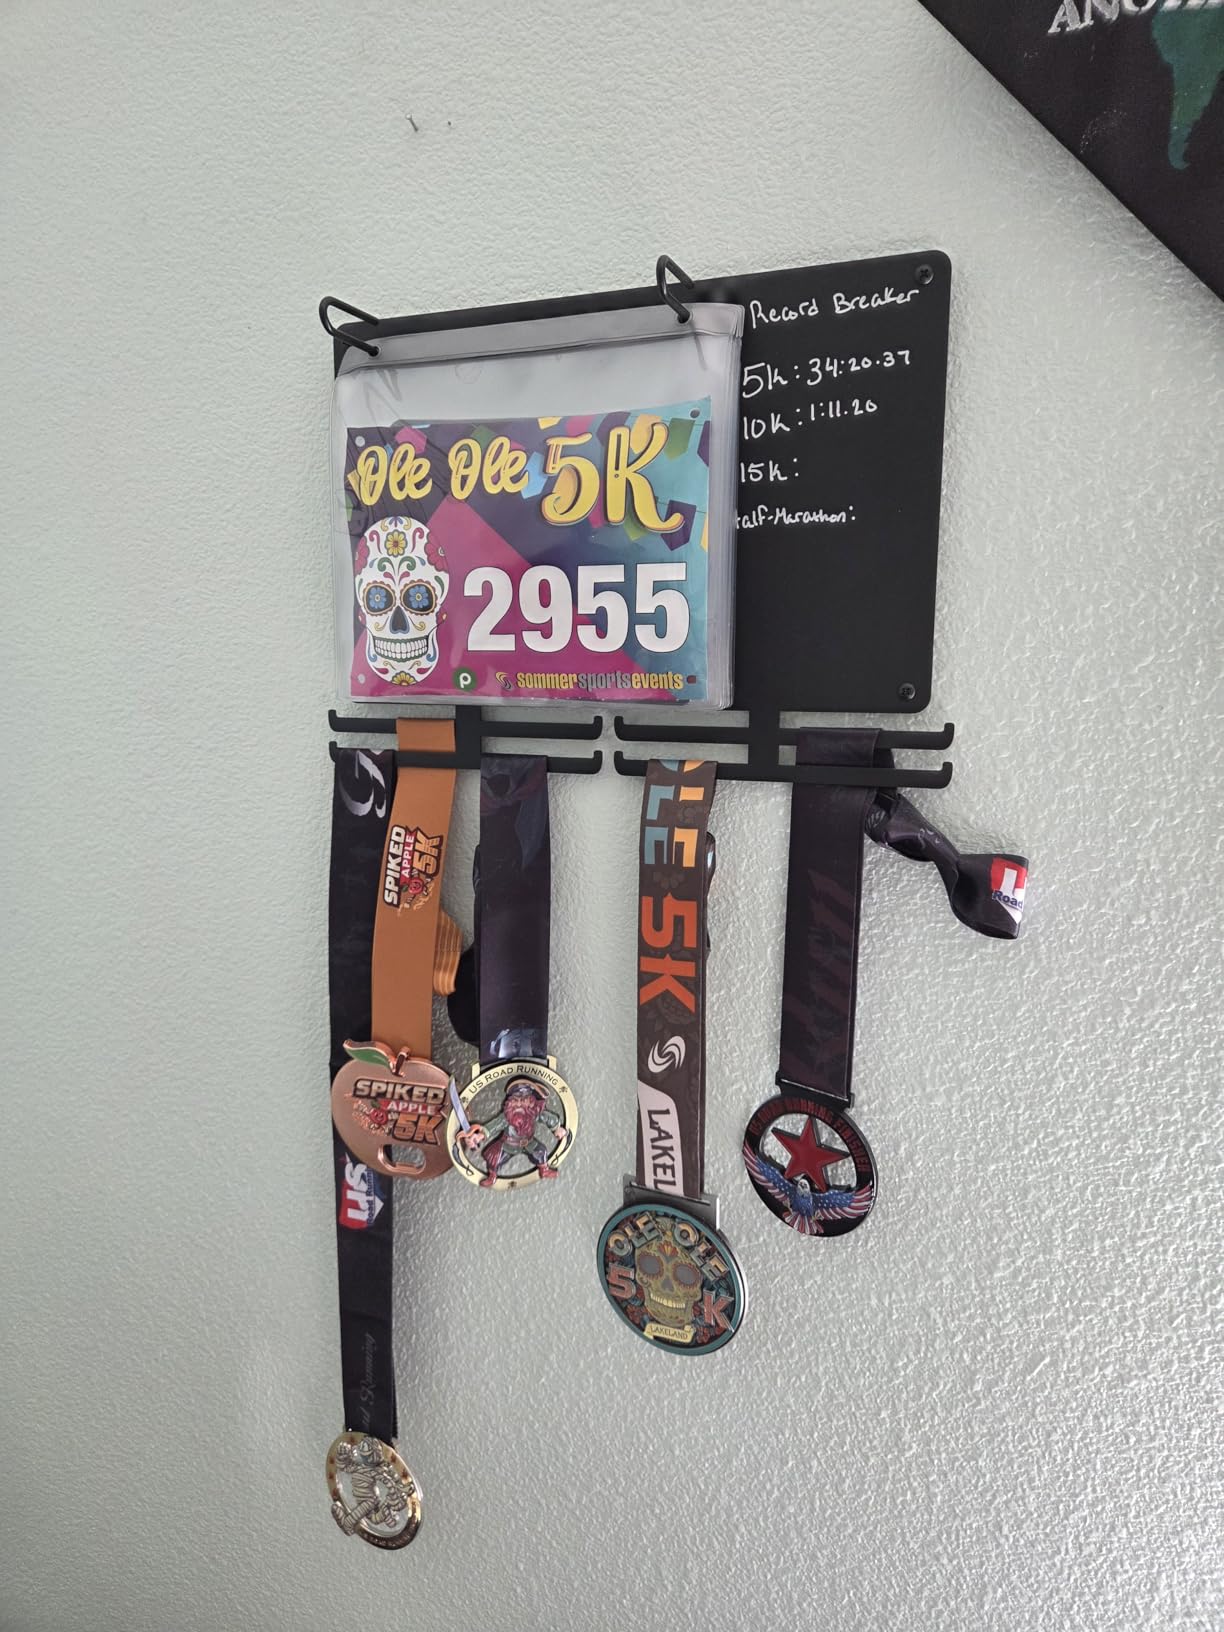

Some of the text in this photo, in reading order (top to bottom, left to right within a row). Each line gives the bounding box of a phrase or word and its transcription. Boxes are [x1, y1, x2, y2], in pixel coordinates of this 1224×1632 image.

[750, 286, 920, 329] Record Breaker
[810, 398, 878, 422] 1:11.20
[357, 421, 686, 532] Ole Ole 5K
[462, 562, 690, 653] 2955
[383, 825, 407, 906] SPIKED
[401, 833, 417, 879] APPLE
[412, 830, 442, 875] 5K
[991, 889, 1024, 909] Road
[639, 894, 698, 1015] 5K
[353, 1079, 446, 1104] SPIKED
[468, 1064, 559, 1094] US ROAD RUNNING
[386, 1100, 436, 1115] APPLE
[393, 1111, 441, 1145] 5K
[608, 1211, 730, 1281] OLE OLE
[649, 1325, 689, 1340] LAKELAND
